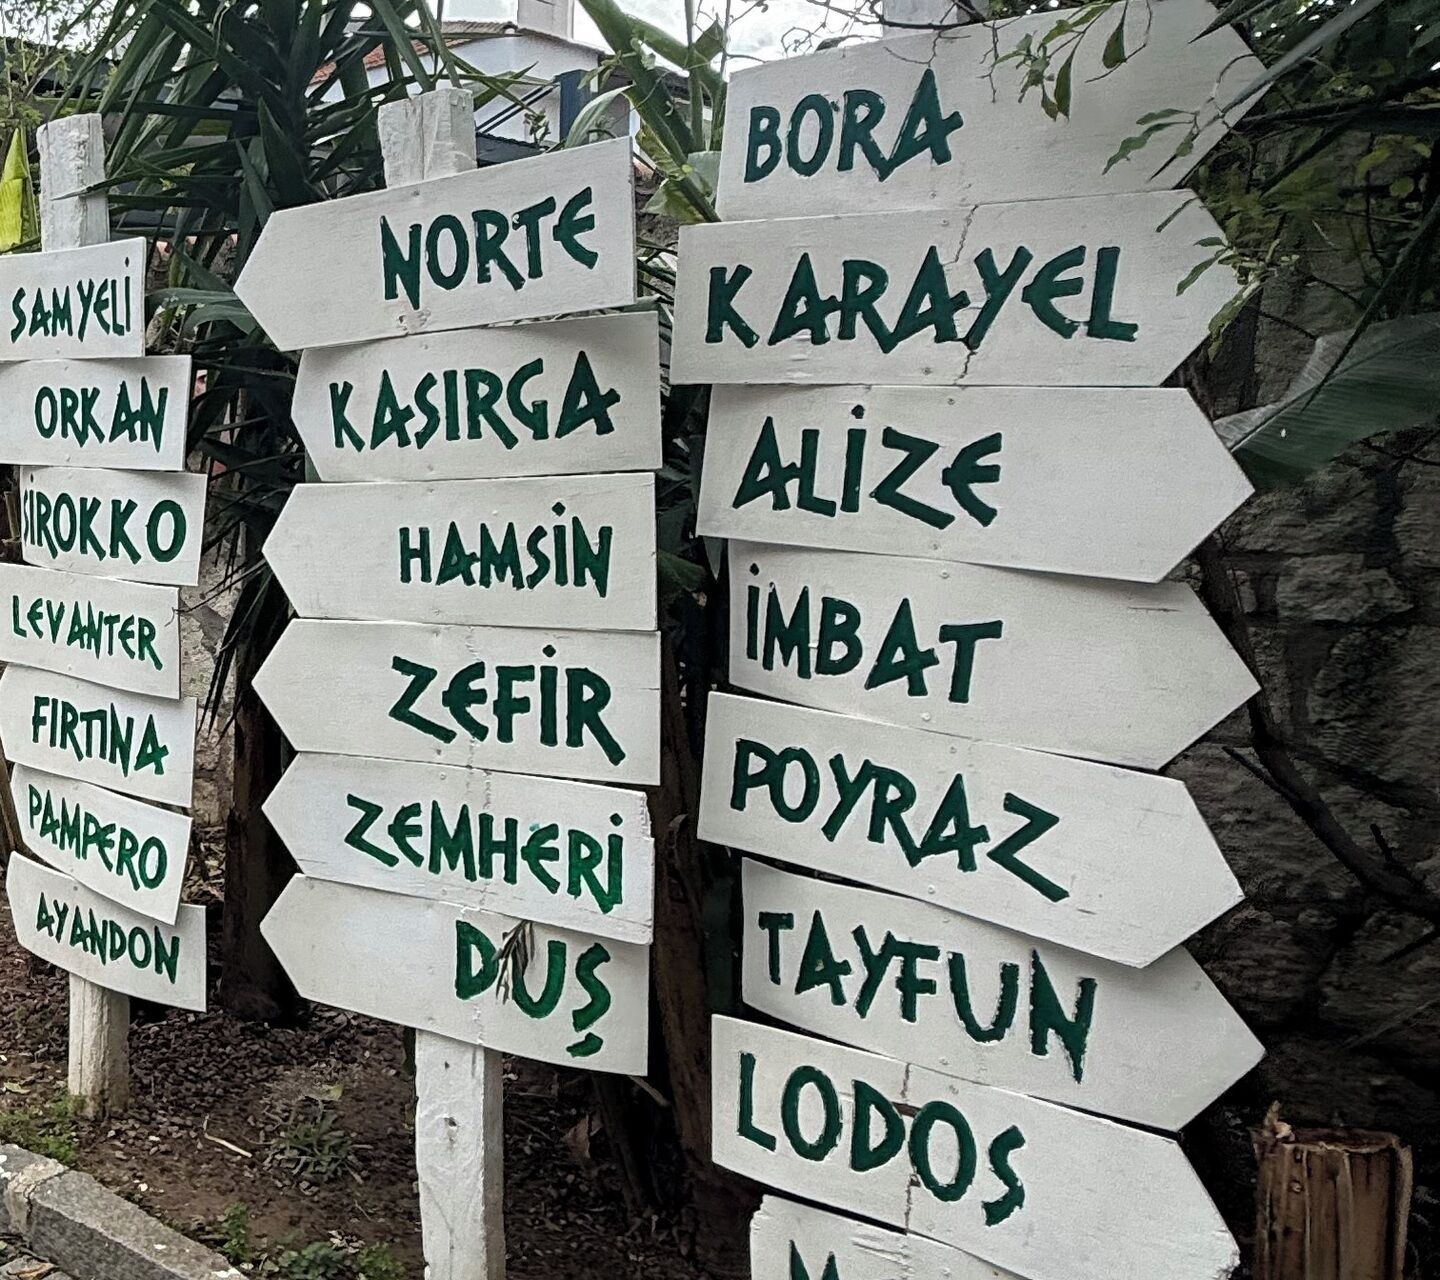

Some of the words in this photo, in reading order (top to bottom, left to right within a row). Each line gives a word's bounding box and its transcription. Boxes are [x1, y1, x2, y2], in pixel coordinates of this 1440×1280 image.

[742, 68, 964, 184] BORA
[379, 186, 600, 310] NORTE
[704, 244, 1140, 354] KARAYEL
[34, 376, 169, 453] ORKAN
[328, 350, 621, 453] KASIRGA
[23, 472, 188, 565] SİROKKO
[732, 404, 1004, 531] ALİZE
[398, 500, 614, 598] HAMSİN
[11, 594, 165, 672] LEVANTER
[746, 563, 1004, 705] İMBAT
[31, 694, 170, 778] FIRTINA
[388, 643, 627, 767] ZEFİR
[27, 783, 169, 892] PAMPERO
[343, 792, 625, 915] ZEMHERİ
[730, 737, 1071, 903] POYRAZ
[35, 891, 181, 985] AYANDON
[454, 919, 612, 1059] DUŞ
[757, 908, 1098, 1085] TAYFUN
[736, 1051, 1027, 1229] LODOS
